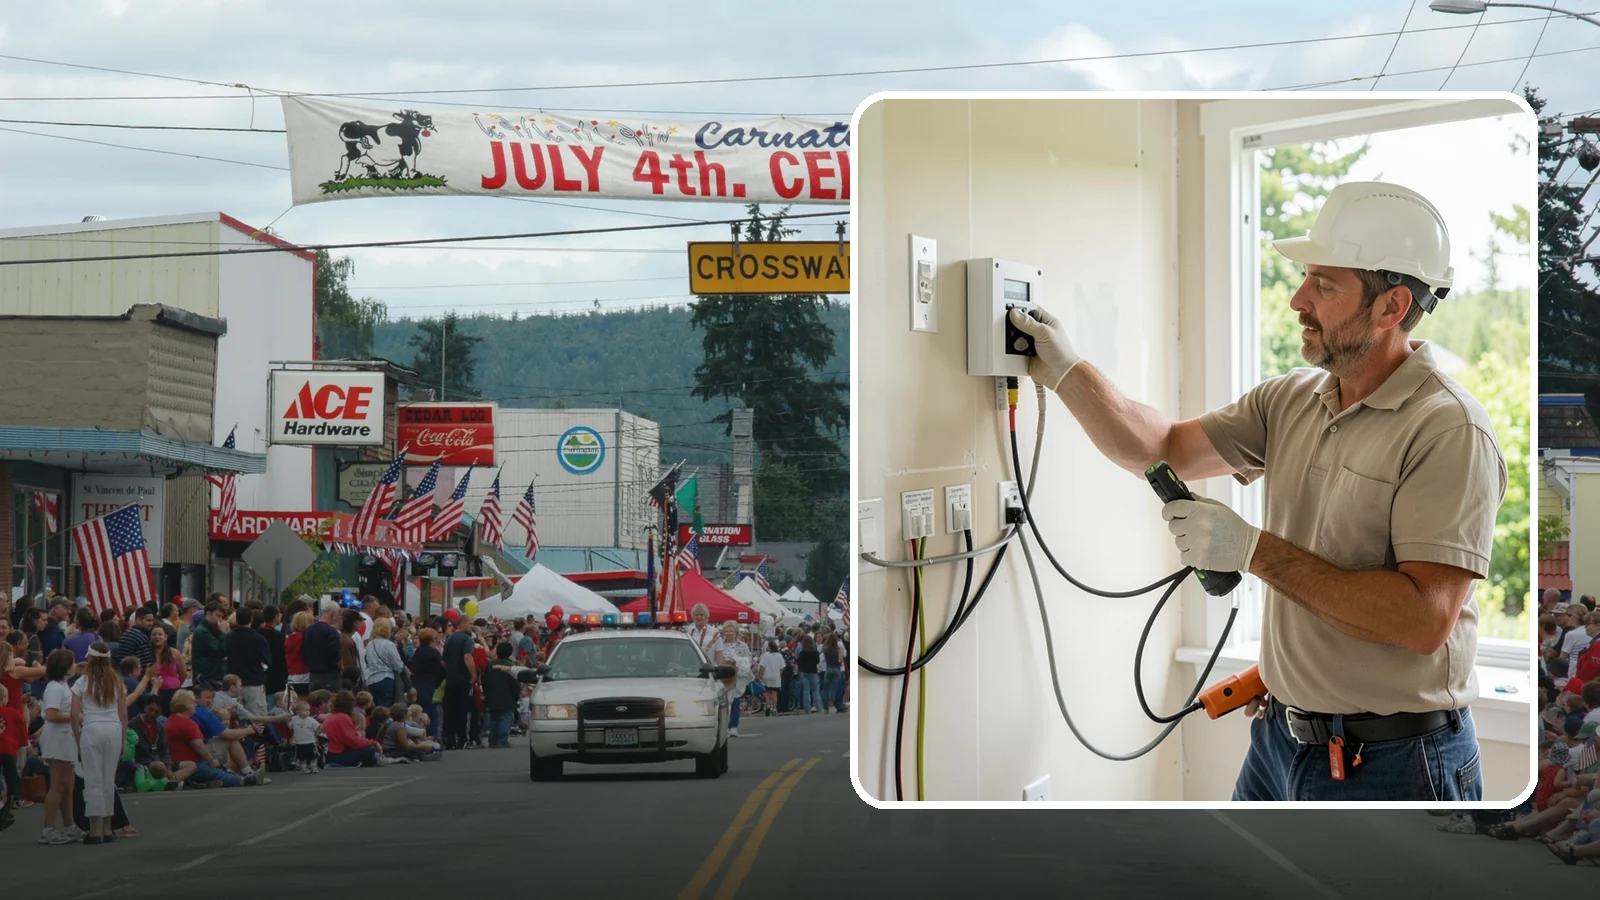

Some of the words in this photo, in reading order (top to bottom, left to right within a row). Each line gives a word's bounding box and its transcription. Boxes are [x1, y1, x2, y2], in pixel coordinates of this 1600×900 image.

[481, 141, 605, 192] JULY
[633, 149, 746, 198] 4th.
[697, 254, 850, 280] CROSSWA
[283, 380, 374, 420] ACE
[406, 409, 453, 422] CEDAR
[283, 421, 371, 437] Hardware
[416, 428, 477, 447] Coca-Cola
[353, 467, 384, 480] Simpl
[83, 484, 94, 494] St.
[95, 484, 125, 494] Vincent
[126, 485, 136, 494] de
[137, 485, 155, 495] Paul
[81, 503, 154, 522] THT
[688, 526, 742, 535] CRNATION
[699, 535, 731, 544] GLASS
